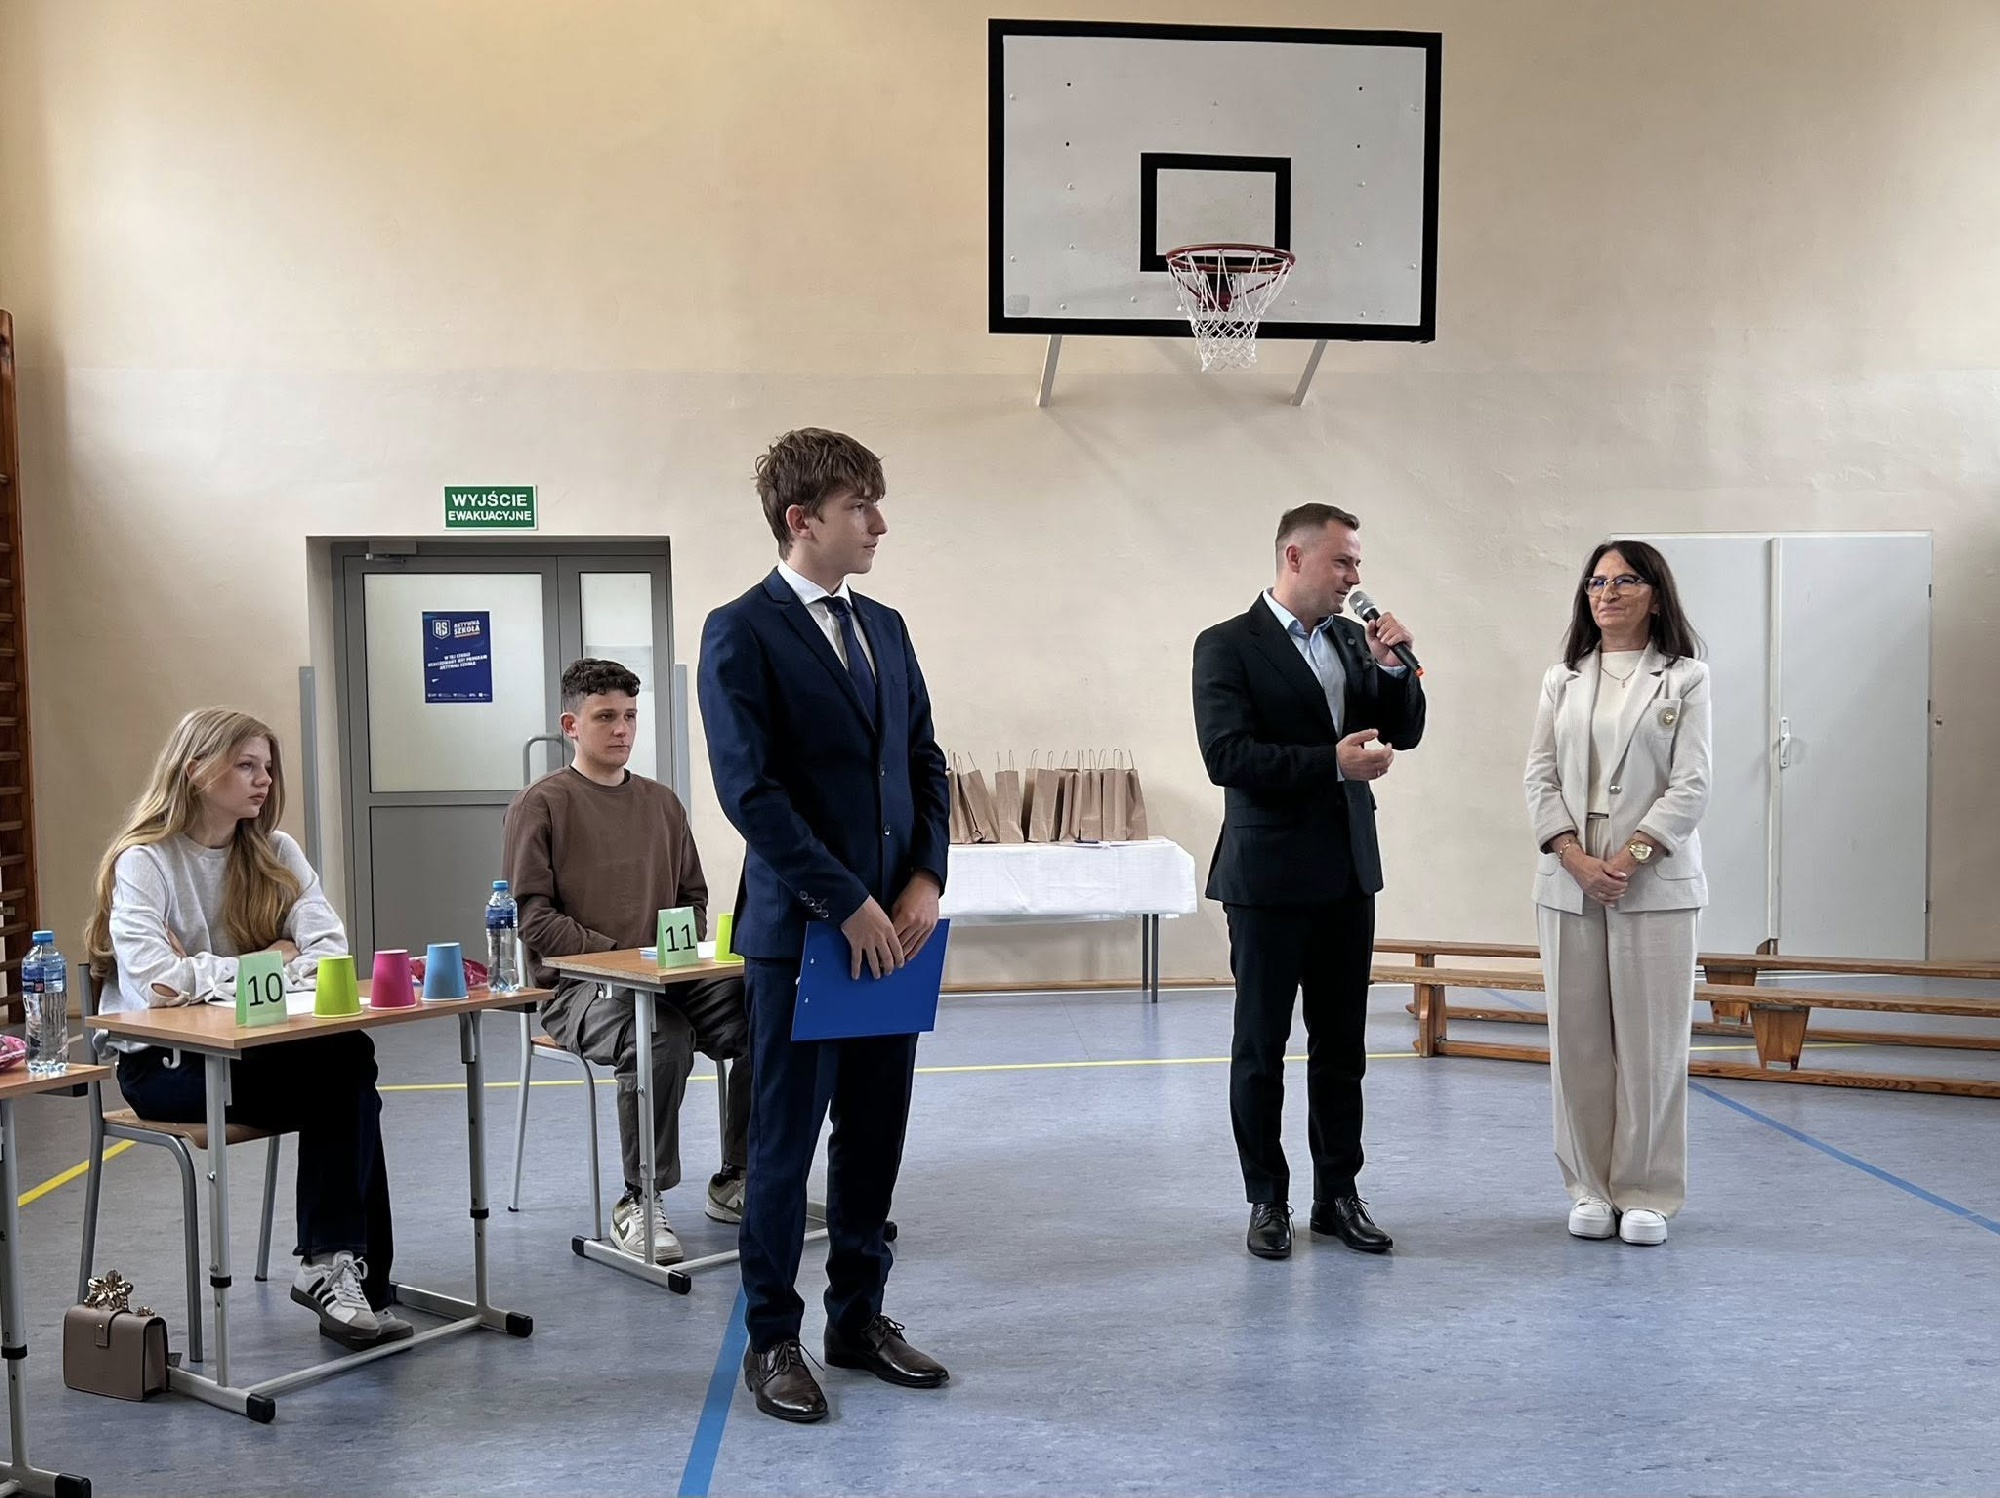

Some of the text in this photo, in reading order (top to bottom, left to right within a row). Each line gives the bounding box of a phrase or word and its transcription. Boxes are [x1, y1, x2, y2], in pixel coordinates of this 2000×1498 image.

[452, 490, 527, 506] WYJŚCIE
[448, 511, 532, 521] EWAKUACYJNE
[454, 625, 480, 635] SZKOŁA
[665, 924, 695, 952] 11
[247, 972, 283, 1007] 10
